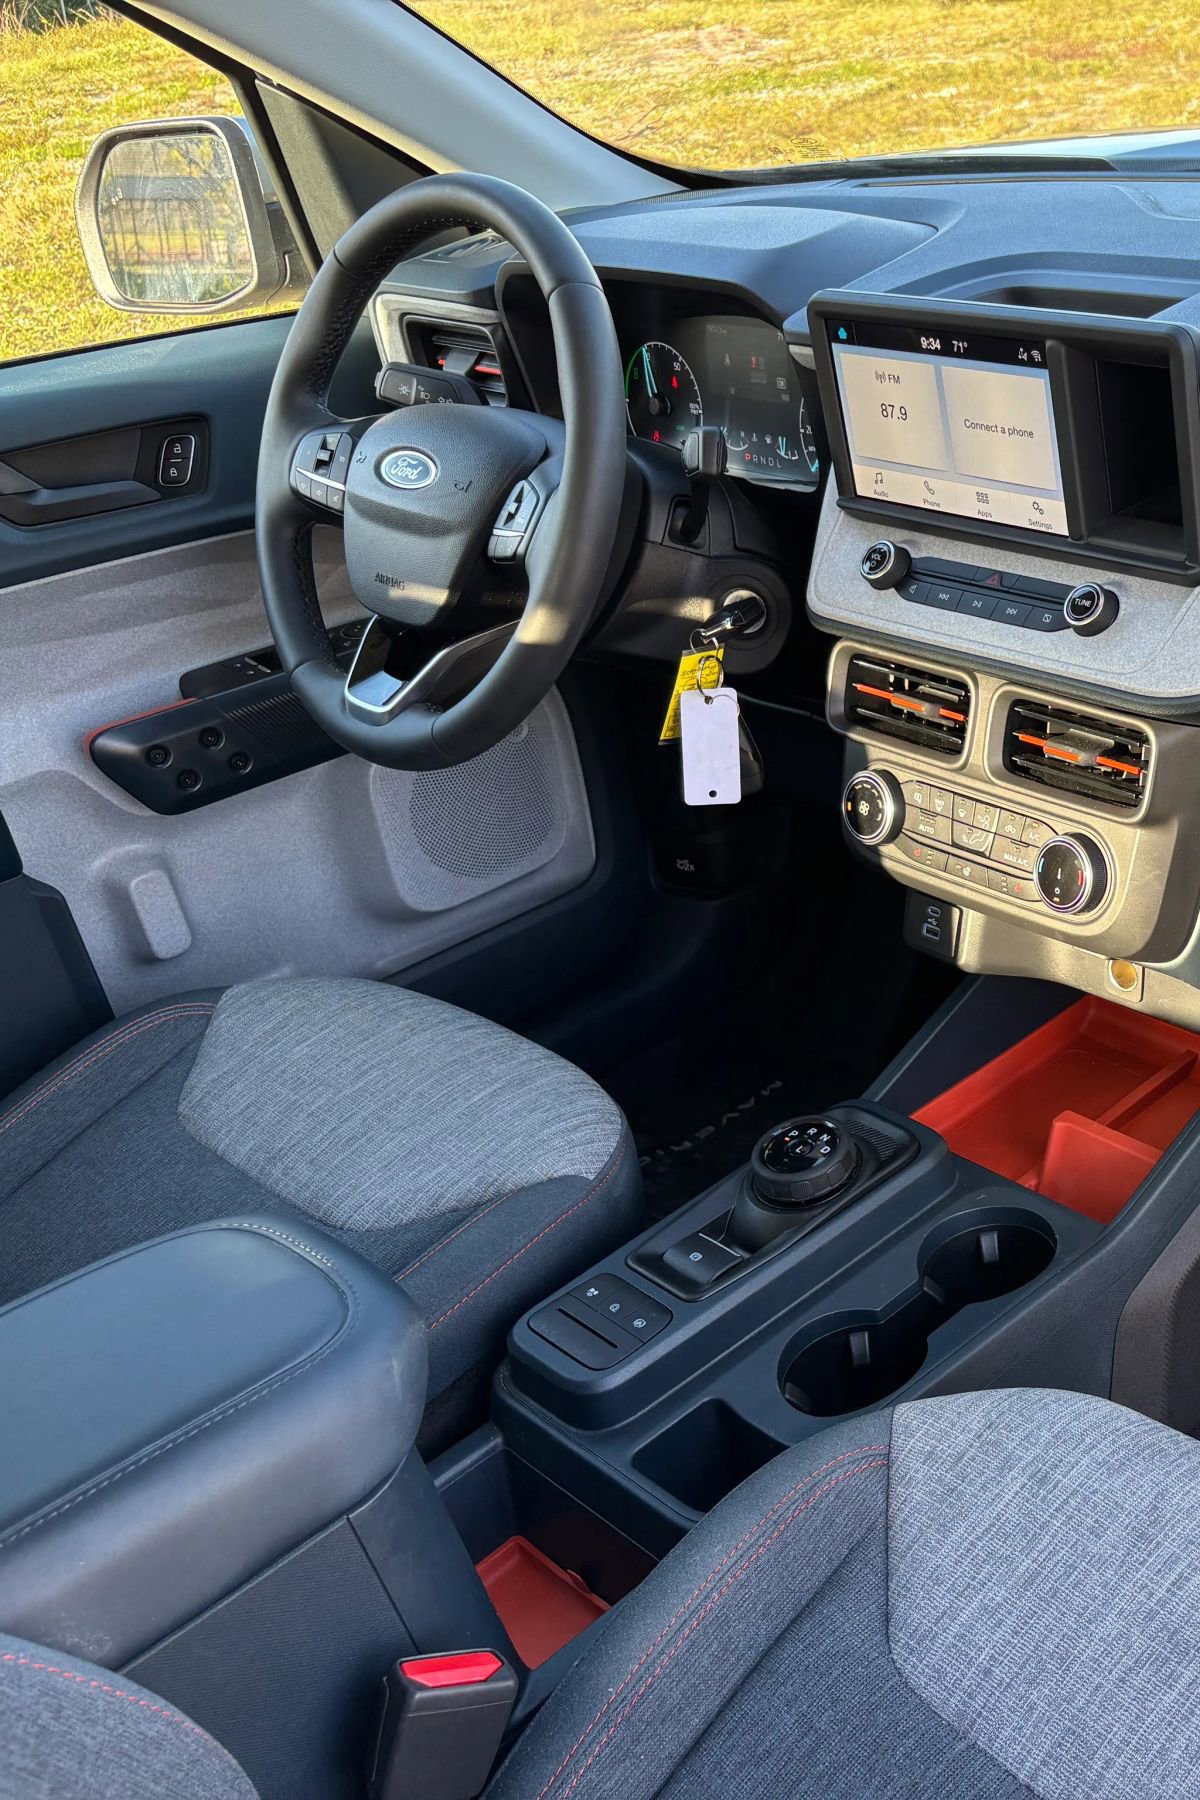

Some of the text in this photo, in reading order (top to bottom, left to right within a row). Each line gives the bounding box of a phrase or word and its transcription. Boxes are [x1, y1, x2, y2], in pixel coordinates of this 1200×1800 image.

[920, 337, 941, 351] 9:34
[887, 373, 901, 385] FM
[880, 403, 908, 421] 87.9
[963, 418, 1034, 438] Connect a phone
[391, 456, 422, 480] Ford
[873, 489, 889, 498] Audio
[922, 498, 941, 508] Phone
[977, 508, 992, 519] Apps
[1028, 518, 1053, 530] Settings
[373, 572, 406, 591] AIRBAG
[1074, 598, 1092, 608] TUNE
[918, 824, 935, 834] AUTO
[1003, 852, 1029, 867] MAX A/C
[806, 1127, 818, 1136] R
[819, 1133, 831, 1142] N
[795, 1145, 803, 1153] L
[820, 1145, 831, 1154] D
